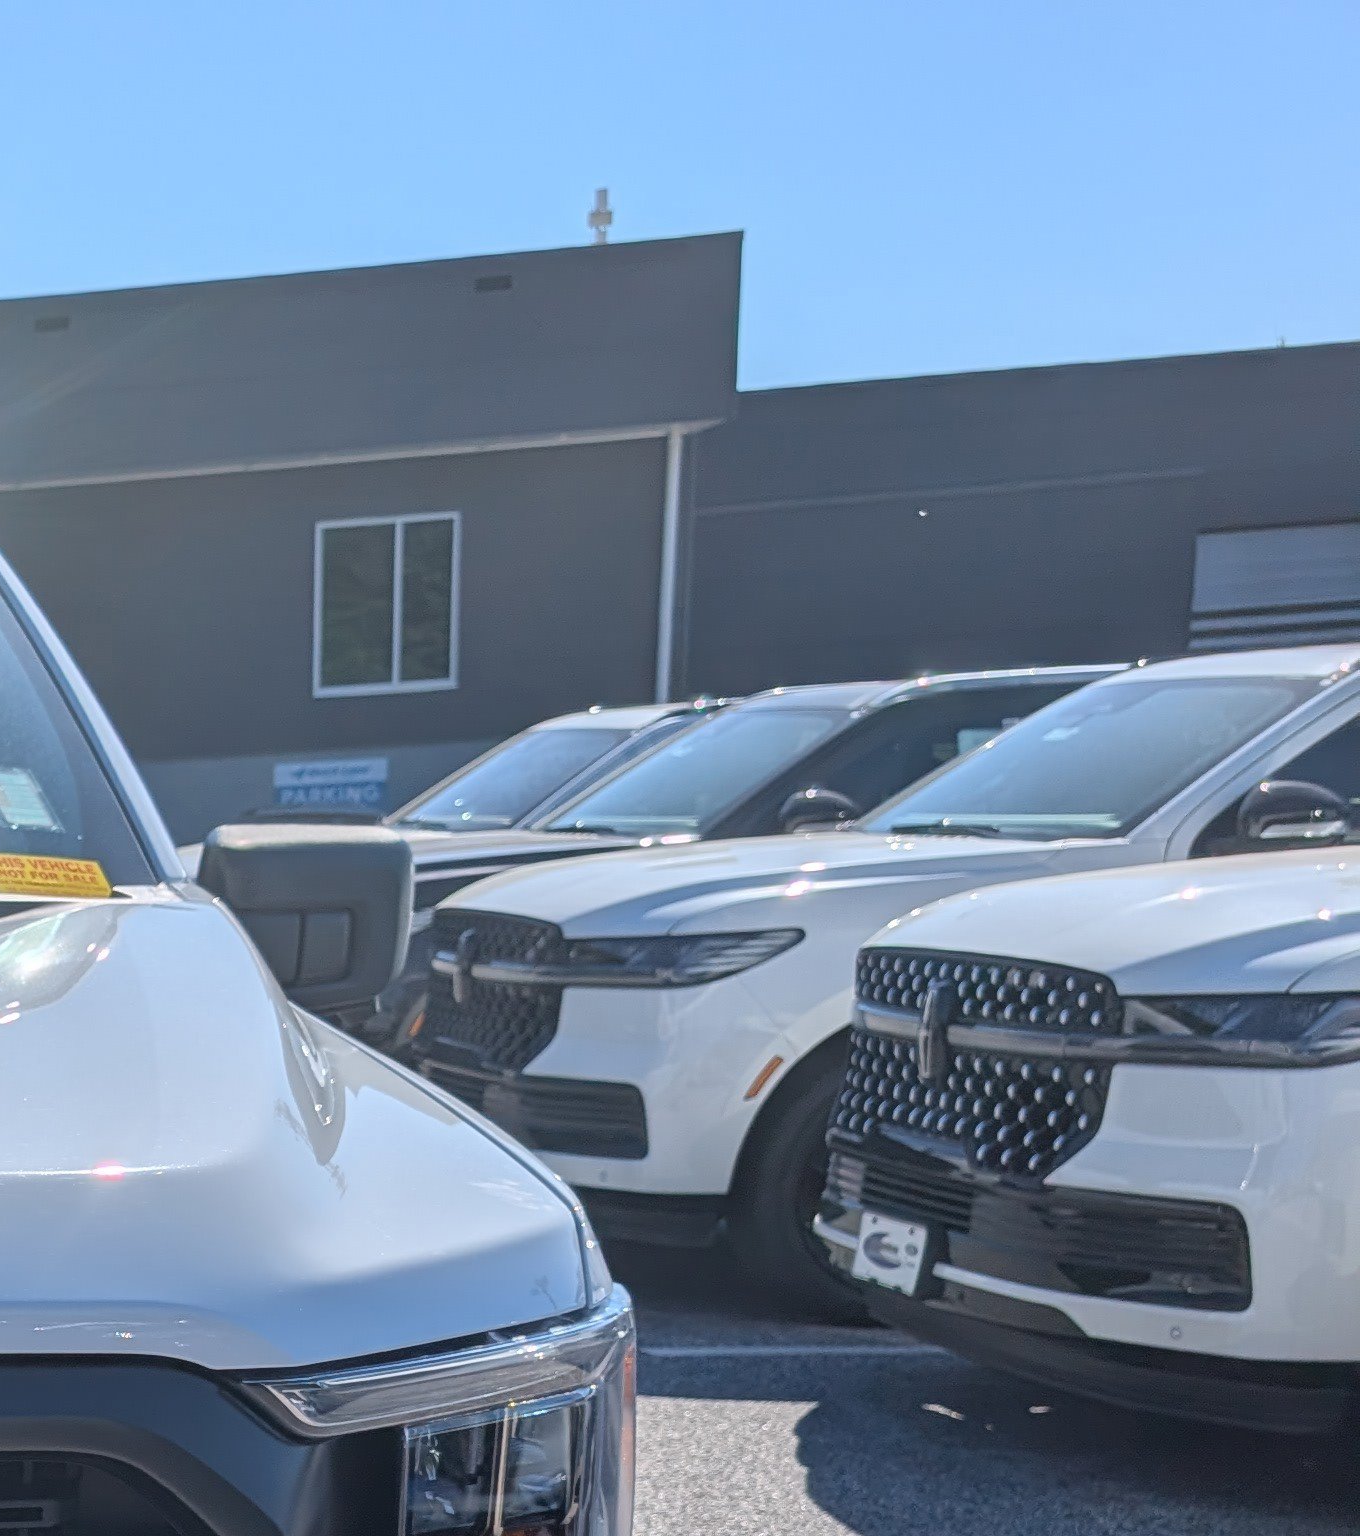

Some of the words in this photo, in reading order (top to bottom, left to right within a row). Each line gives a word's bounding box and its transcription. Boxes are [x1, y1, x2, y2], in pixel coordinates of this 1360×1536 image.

[27, 858, 97, 875] VEHICLE
[30, 871, 58, 881] FOR
[63, 873, 97, 884] SALE
